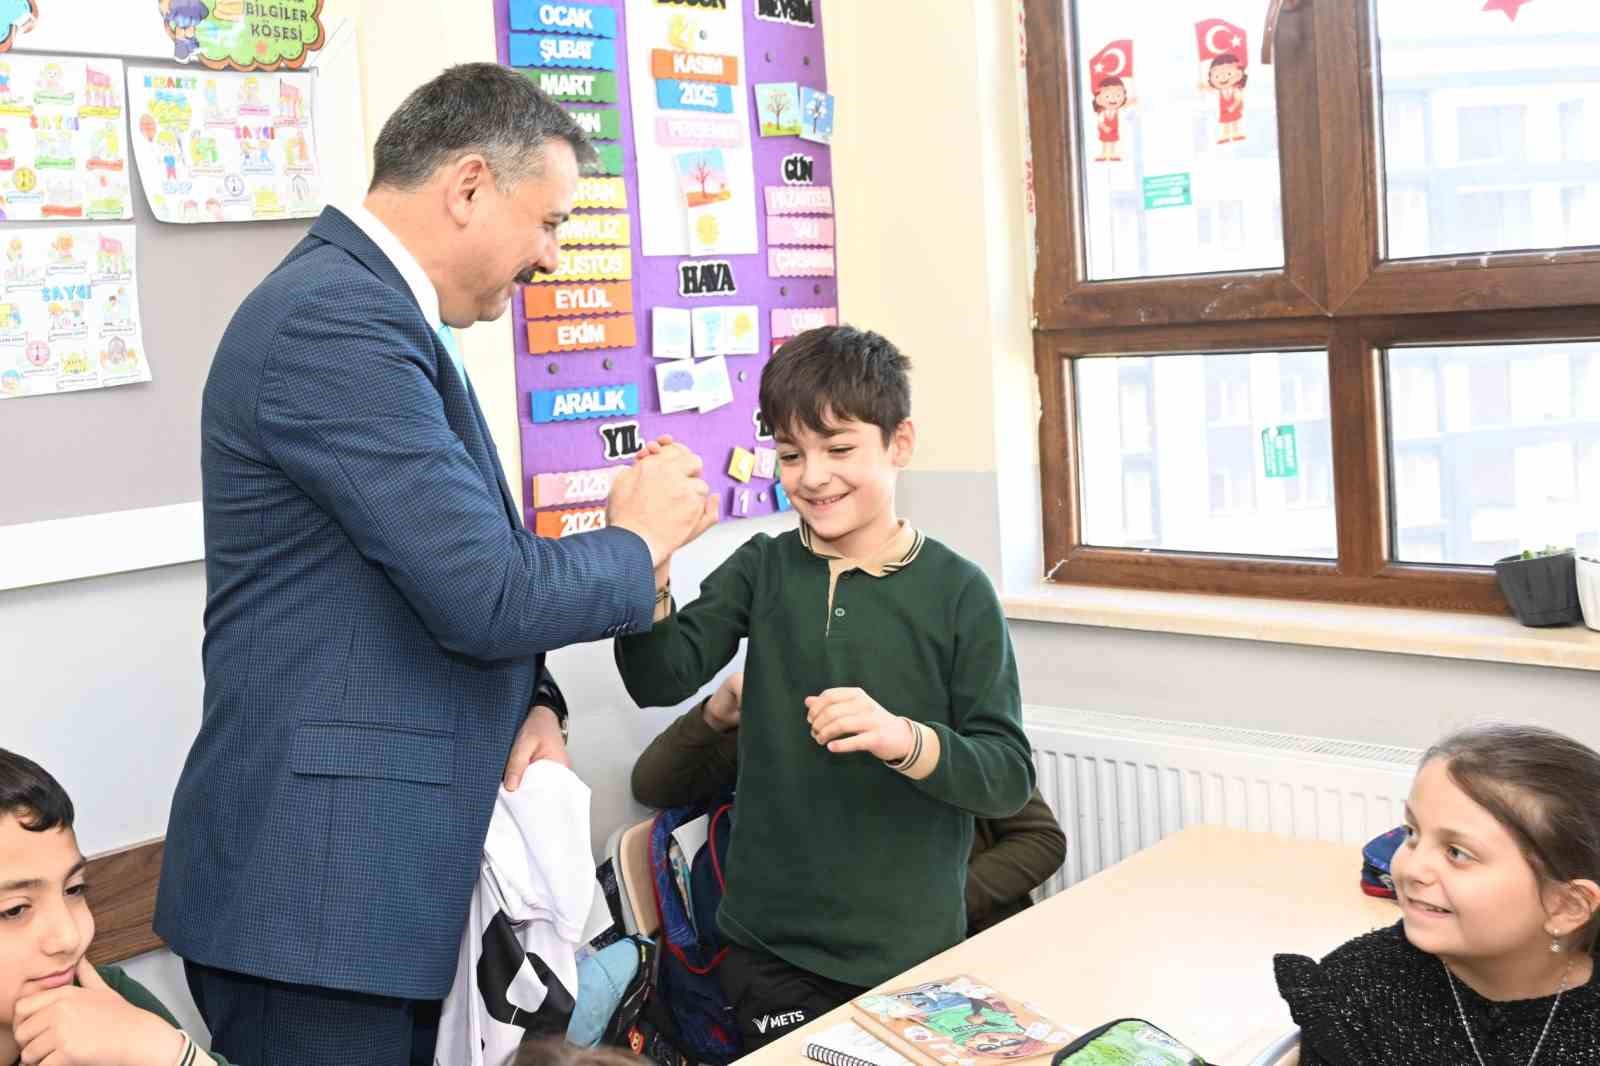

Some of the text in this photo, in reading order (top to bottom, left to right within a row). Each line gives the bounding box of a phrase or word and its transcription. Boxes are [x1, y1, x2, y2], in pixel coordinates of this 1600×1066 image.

[246, 2, 307, 22] BİLGİLER
[540, 5, 593, 28] OCAK
[251, 20, 302, 42] KÖŞESİ
[540, 39, 594, 62] ŞUBAT
[540, 74, 595, 95] MART
[679, 81, 718, 108] 2025
[785, 156, 813, 182] GÜN
[682, 264, 735, 293] HAVA
[41, 284, 92, 302] SAYGI
[555, 287, 611, 309] EYLÜL
[557, 322, 605, 345] EKİM
[553, 389, 626, 416] ARALIK
[603, 424, 643, 457] YIL
